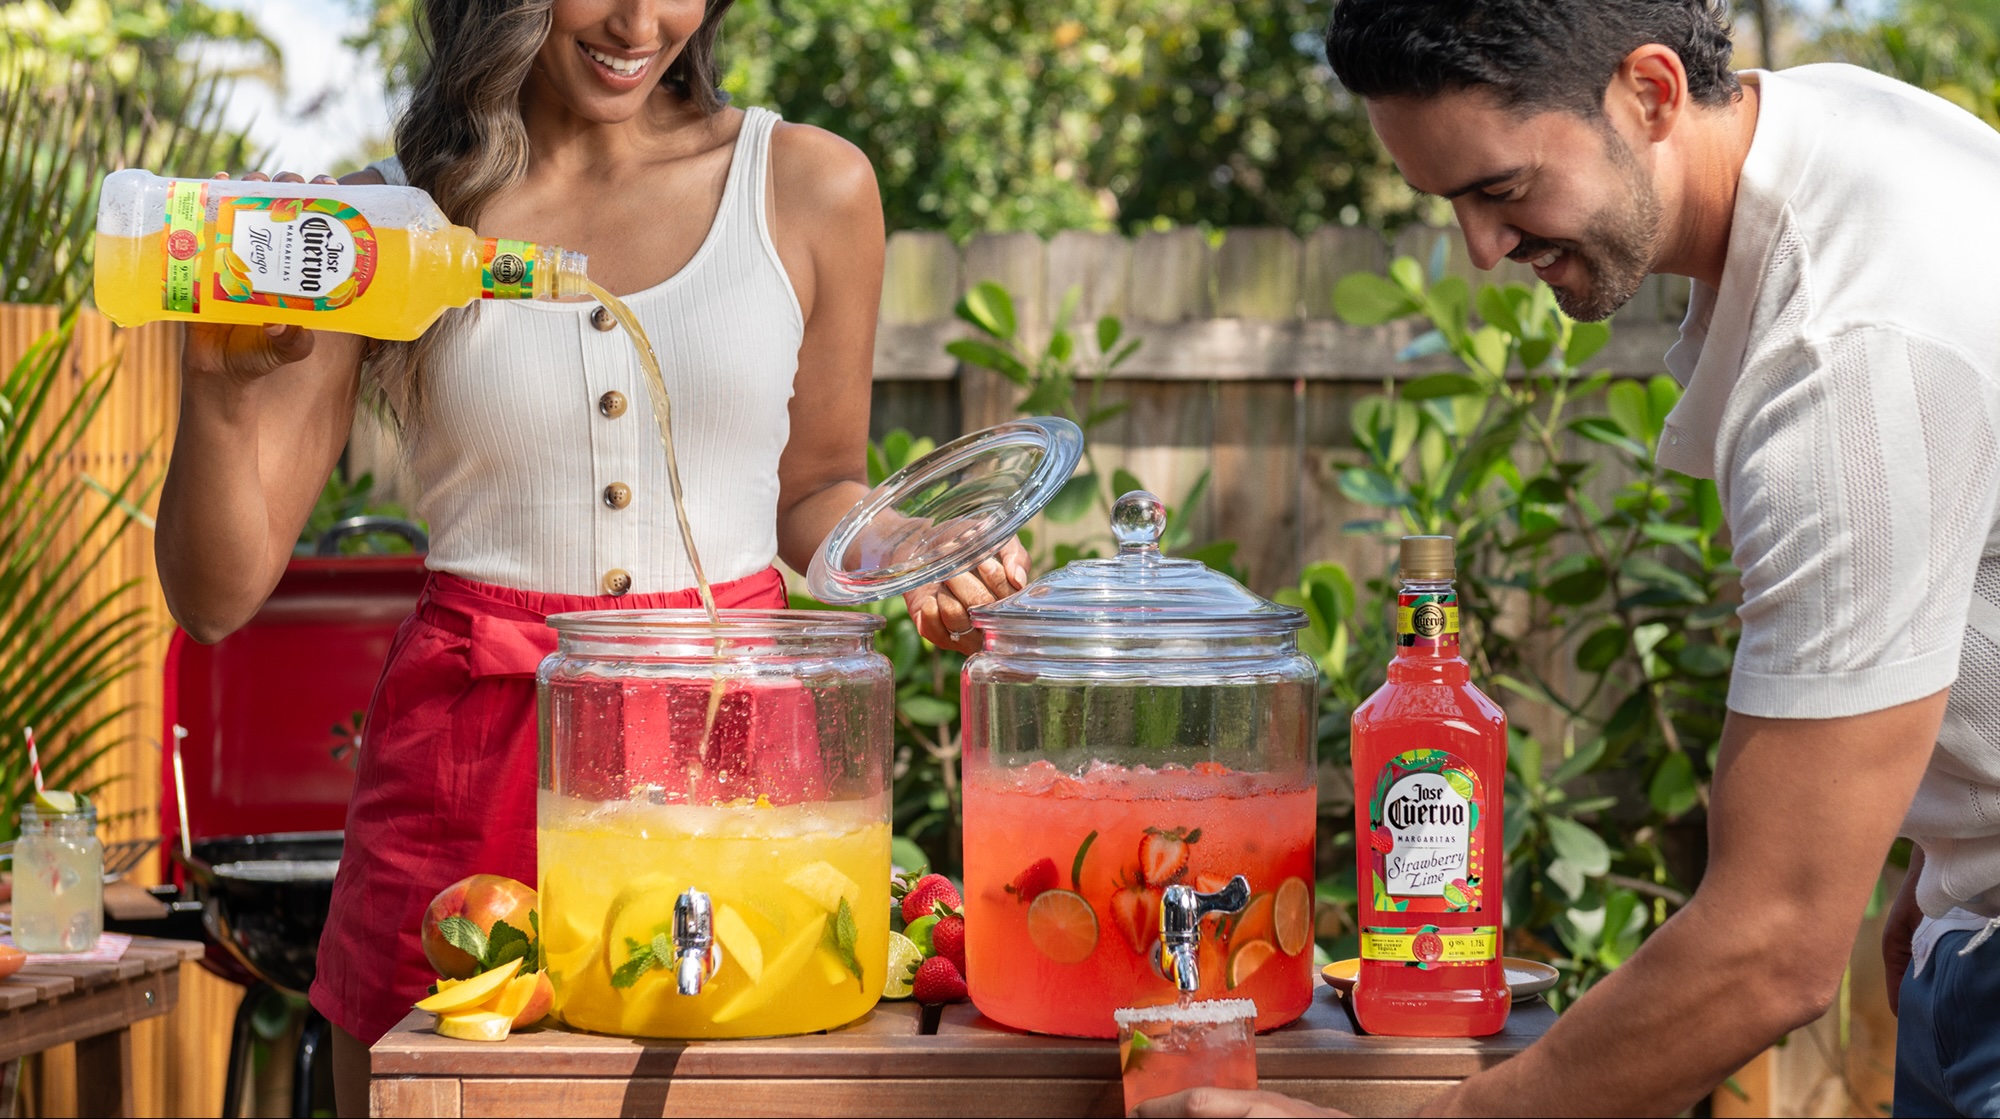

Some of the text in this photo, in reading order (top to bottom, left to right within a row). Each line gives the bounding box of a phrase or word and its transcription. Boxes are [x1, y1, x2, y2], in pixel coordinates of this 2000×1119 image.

[248, 225, 273, 274] Mango
[283, 225, 294, 282] MARGARITAS
[299, 217, 334, 292] Cuervo
[324, 242, 344, 273] Jose
[1412, 783, 1443, 802] Jose
[1388, 795, 1464, 830] Cuervo
[1397, 835, 1456, 843] MARGARITAS
[1388, 850, 1465, 879] Strawberry
[1405, 872, 1444, 889] Lime
